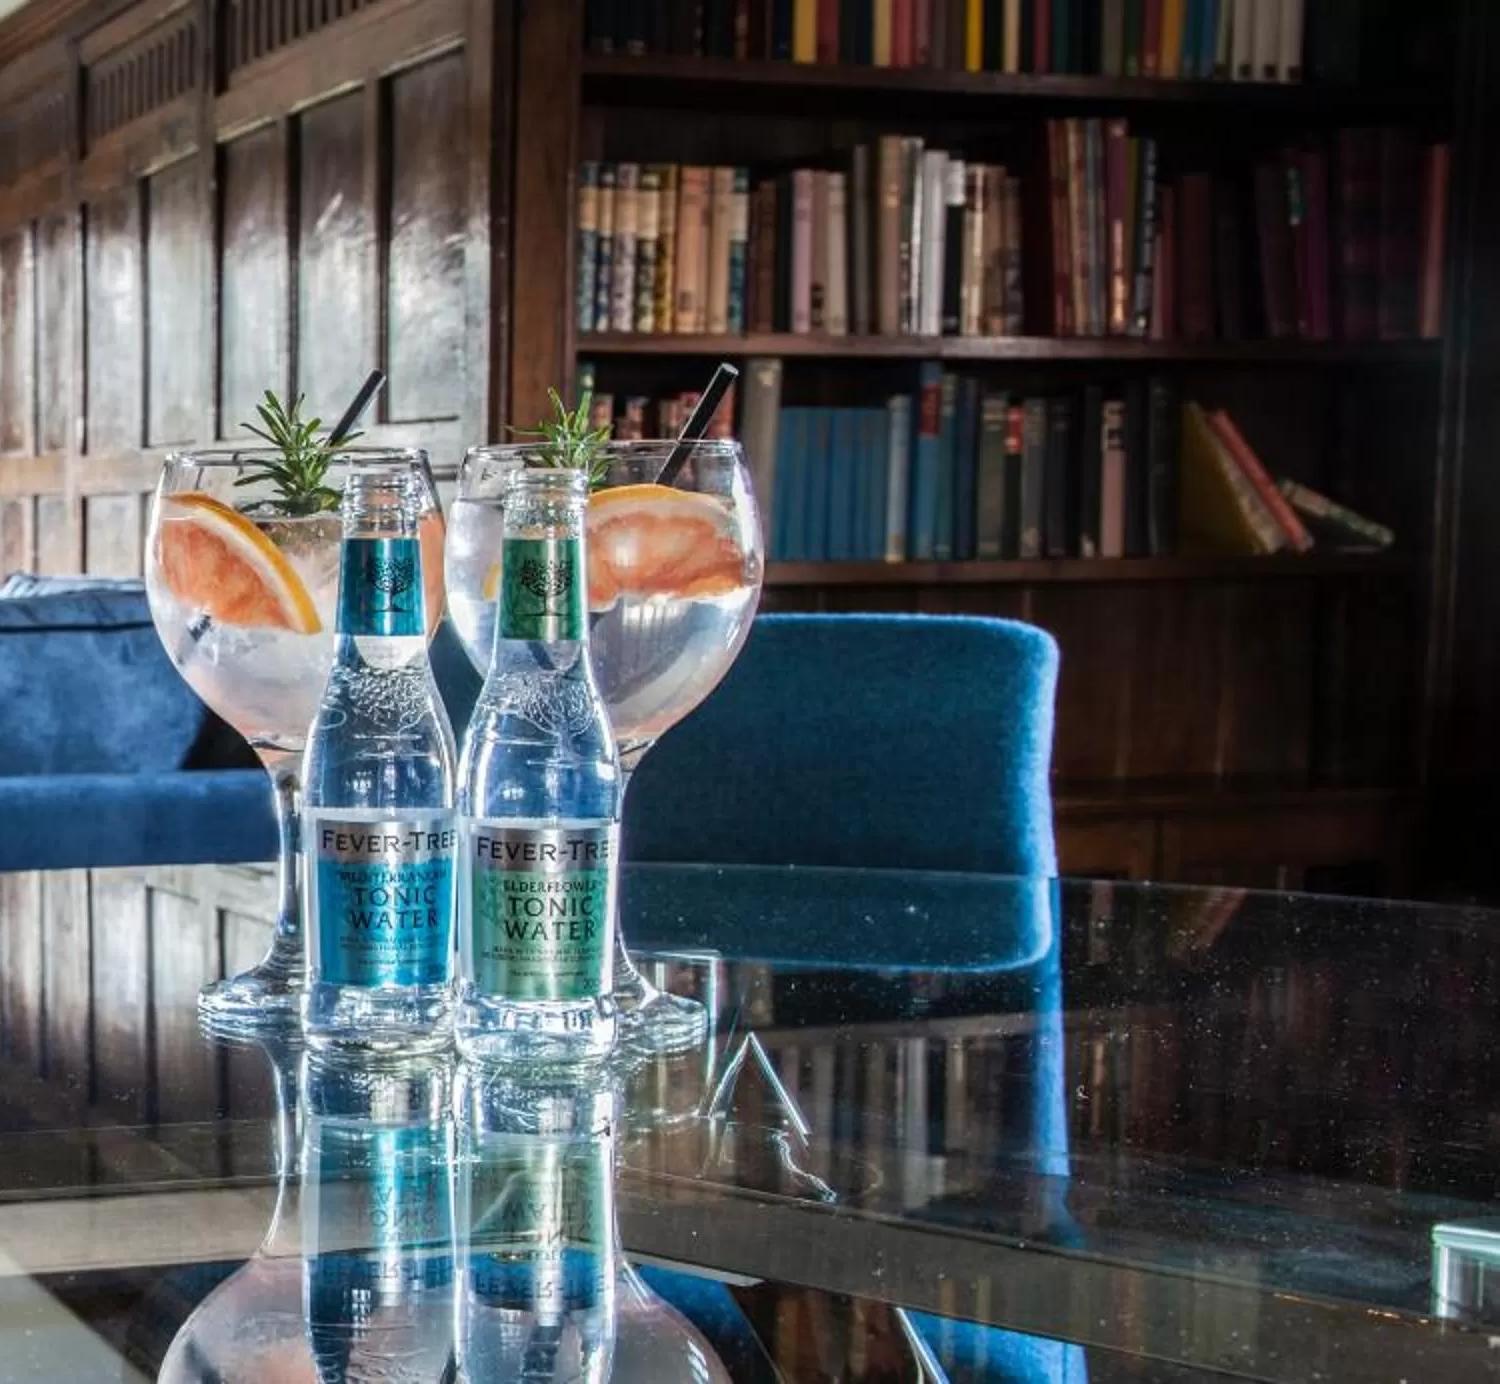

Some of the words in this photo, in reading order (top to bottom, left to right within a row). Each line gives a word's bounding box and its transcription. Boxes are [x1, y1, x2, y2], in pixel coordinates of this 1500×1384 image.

[352, 885, 437, 906] TONIC
[507, 895, 593, 917] TONIC
[349, 909, 438, 929] WATER
[503, 919, 596, 941] WATER
